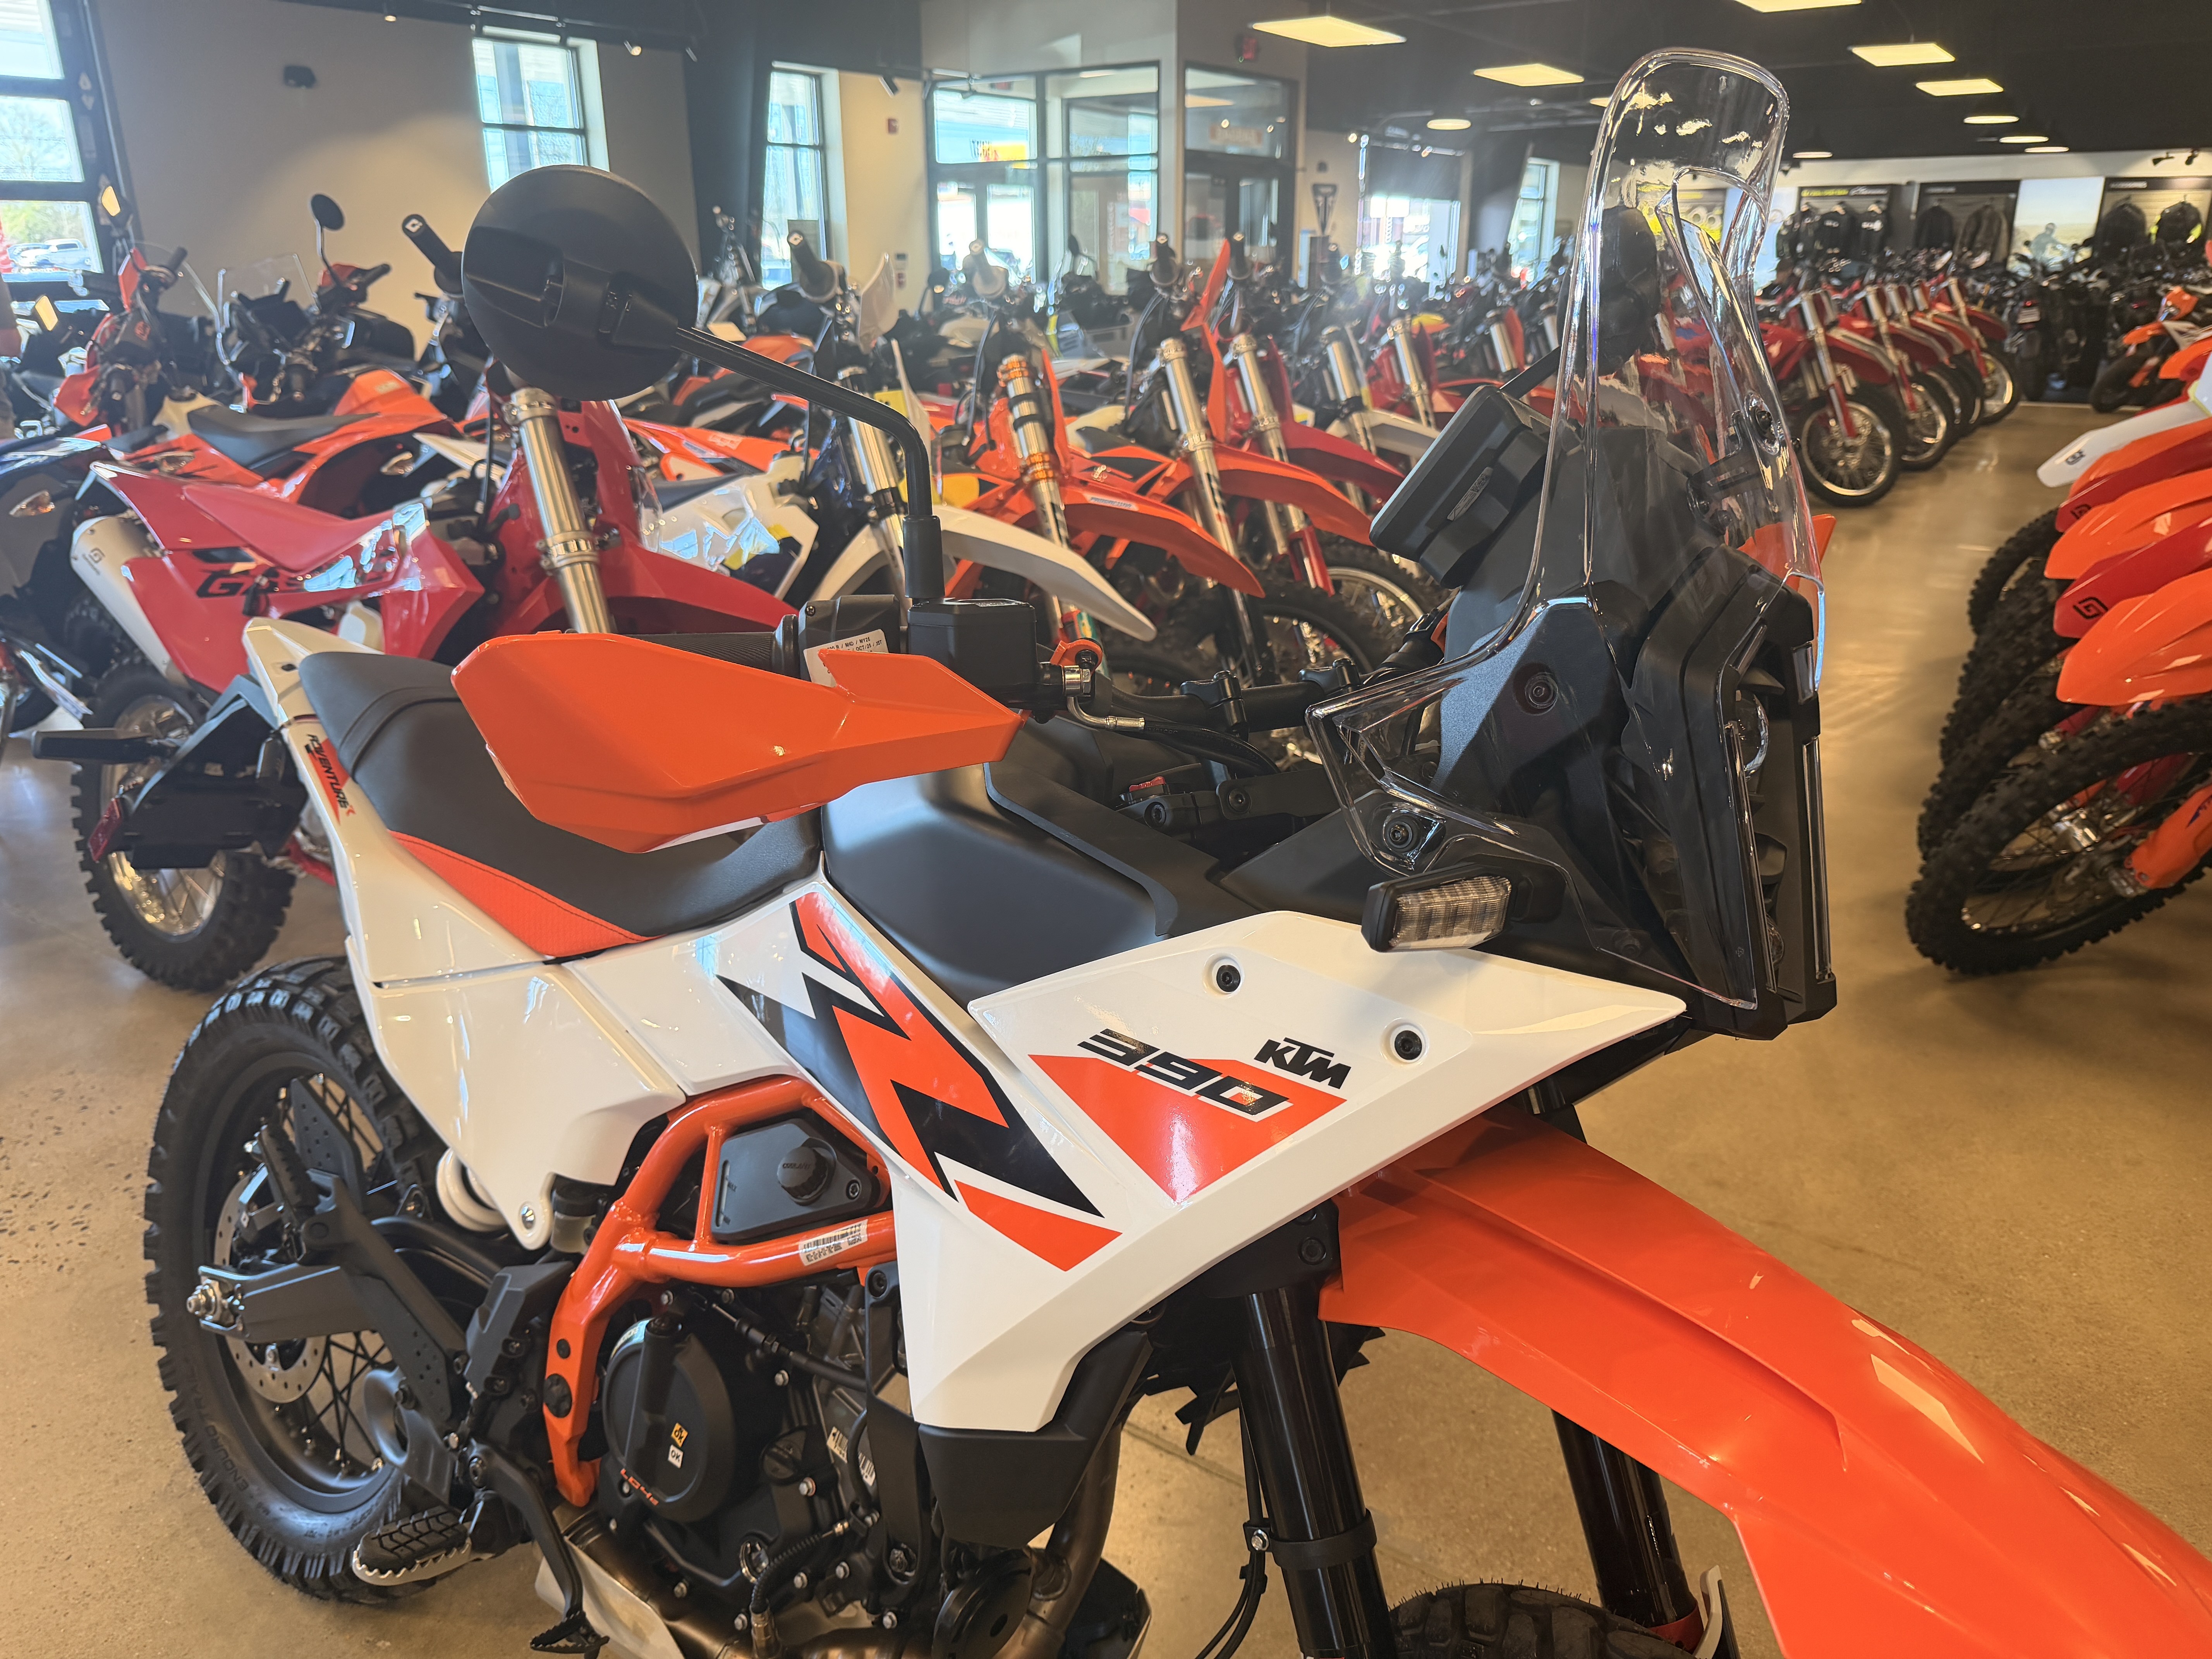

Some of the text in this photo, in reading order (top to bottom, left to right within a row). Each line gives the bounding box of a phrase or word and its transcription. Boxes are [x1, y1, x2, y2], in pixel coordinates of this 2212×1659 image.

[307, 734, 349, 809] ADVENTURE
[1077, 1028, 1290, 1116] 390
[1253, 1037, 1352, 1089] KTM
[671, 1449, 680, 1462] OK
